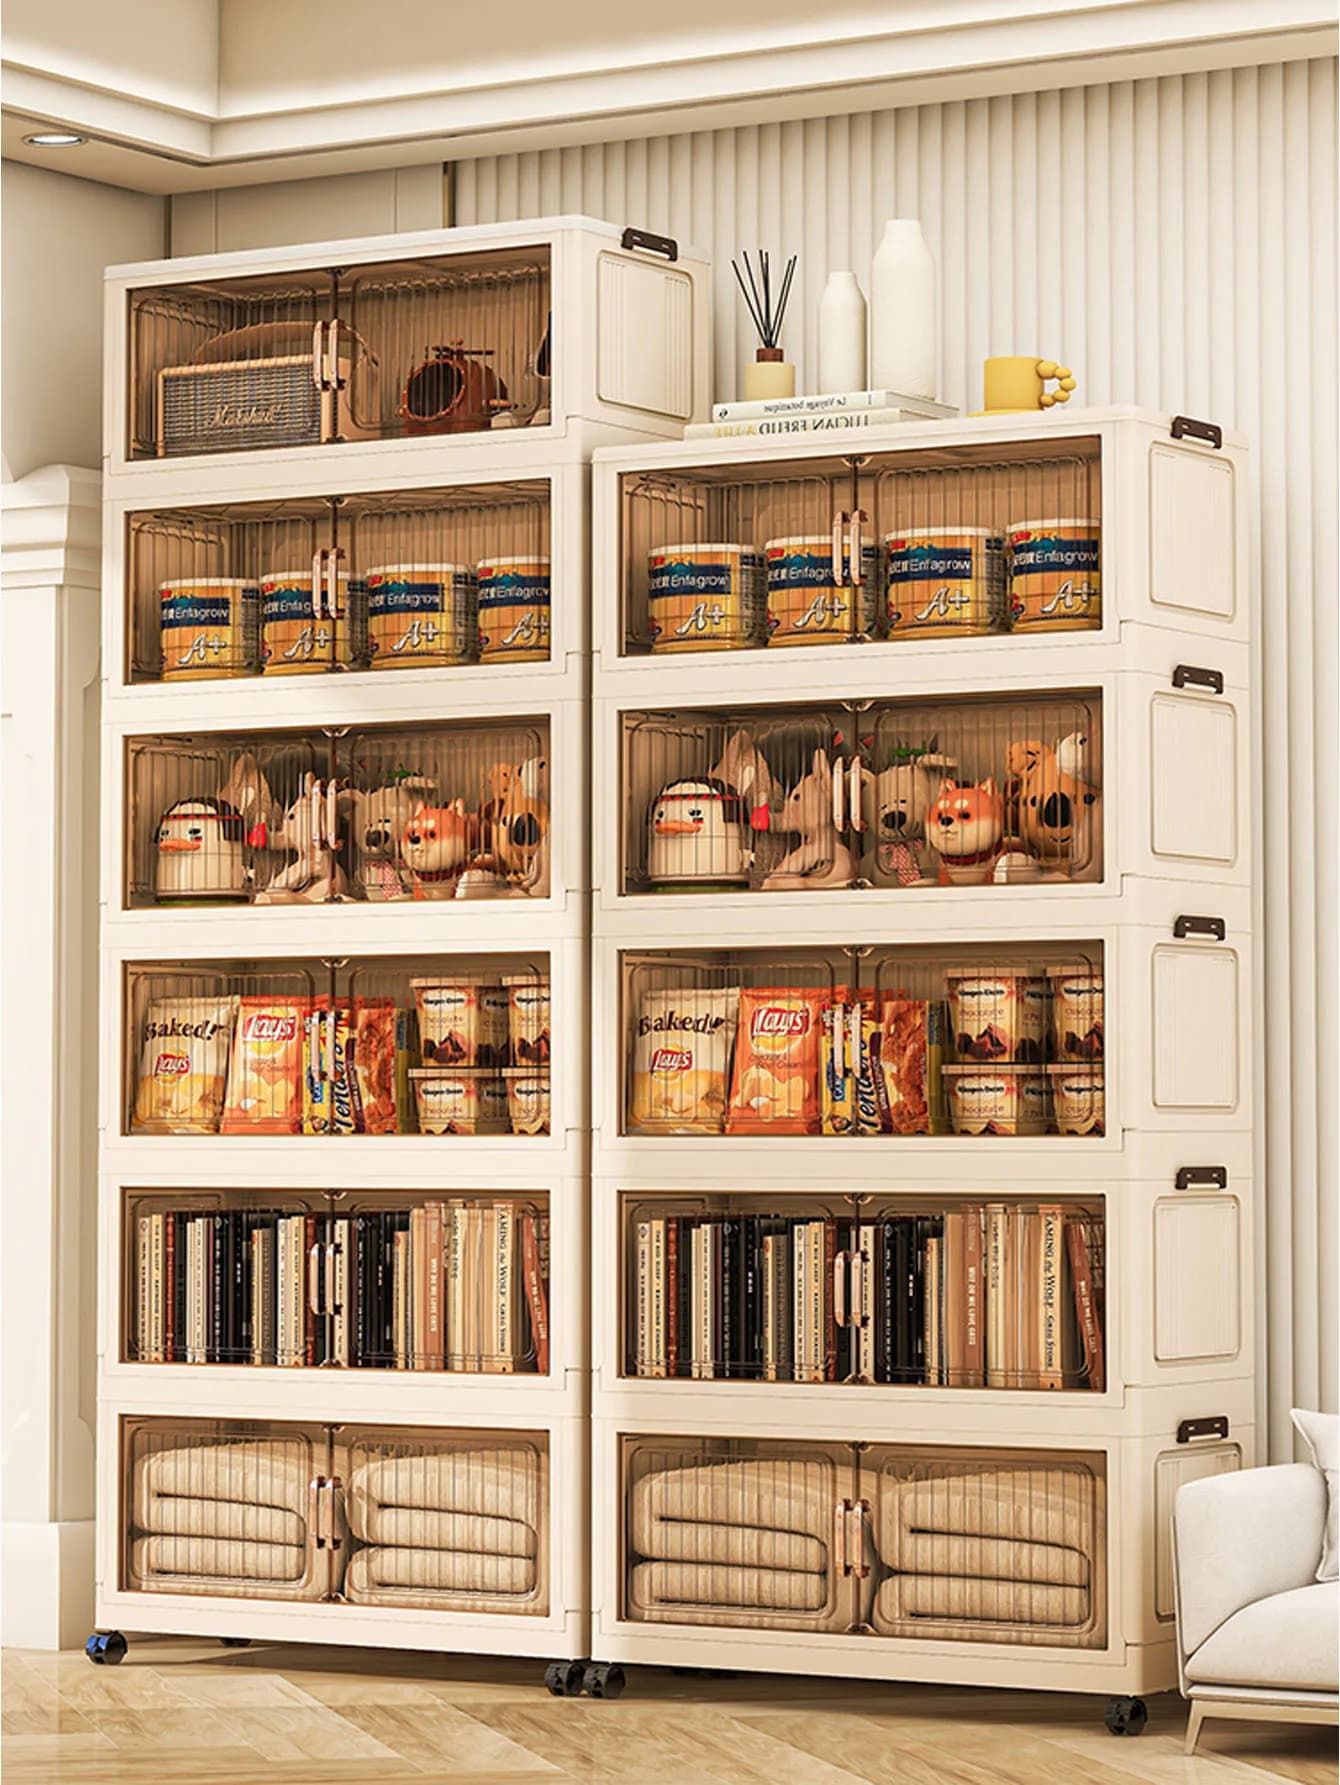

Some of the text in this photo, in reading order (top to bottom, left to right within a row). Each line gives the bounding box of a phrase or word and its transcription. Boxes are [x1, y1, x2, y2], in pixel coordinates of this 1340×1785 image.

[910, 559, 971, 574] Enfagrow
[1036, 550, 1098, 565] Enfagrow
[671, 574, 728, 589] Enfagrow
[1040, 579, 1096, 614] A+
[175, 606, 229, 621] Enfagrow
[675, 601, 725, 635] A+
[793, 595, 847, 629] A+
[915, 586, 970, 621] A+
[283, 626, 330, 658] A+
[392, 620, 439, 650] A+
[501, 612, 549, 645] A+
[178, 633, 227, 664] A+
[1047, 1276, 1055, 1309] WOLF
